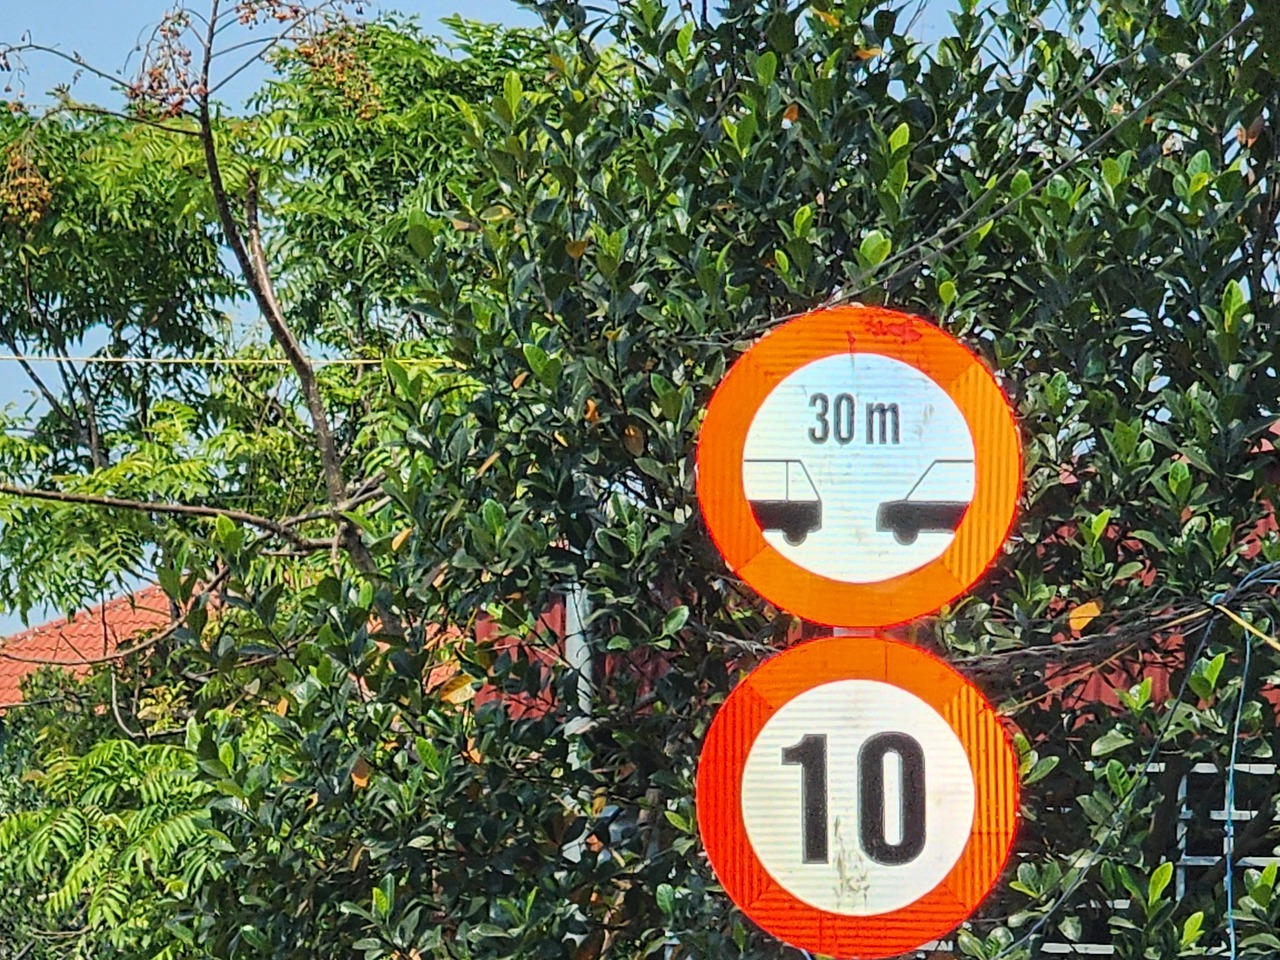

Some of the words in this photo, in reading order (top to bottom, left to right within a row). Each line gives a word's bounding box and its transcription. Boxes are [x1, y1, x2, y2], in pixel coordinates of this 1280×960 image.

[808, 392, 855, 445] 30
[865, 402, 900, 444] m
[781, 731, 926, 866] 10
